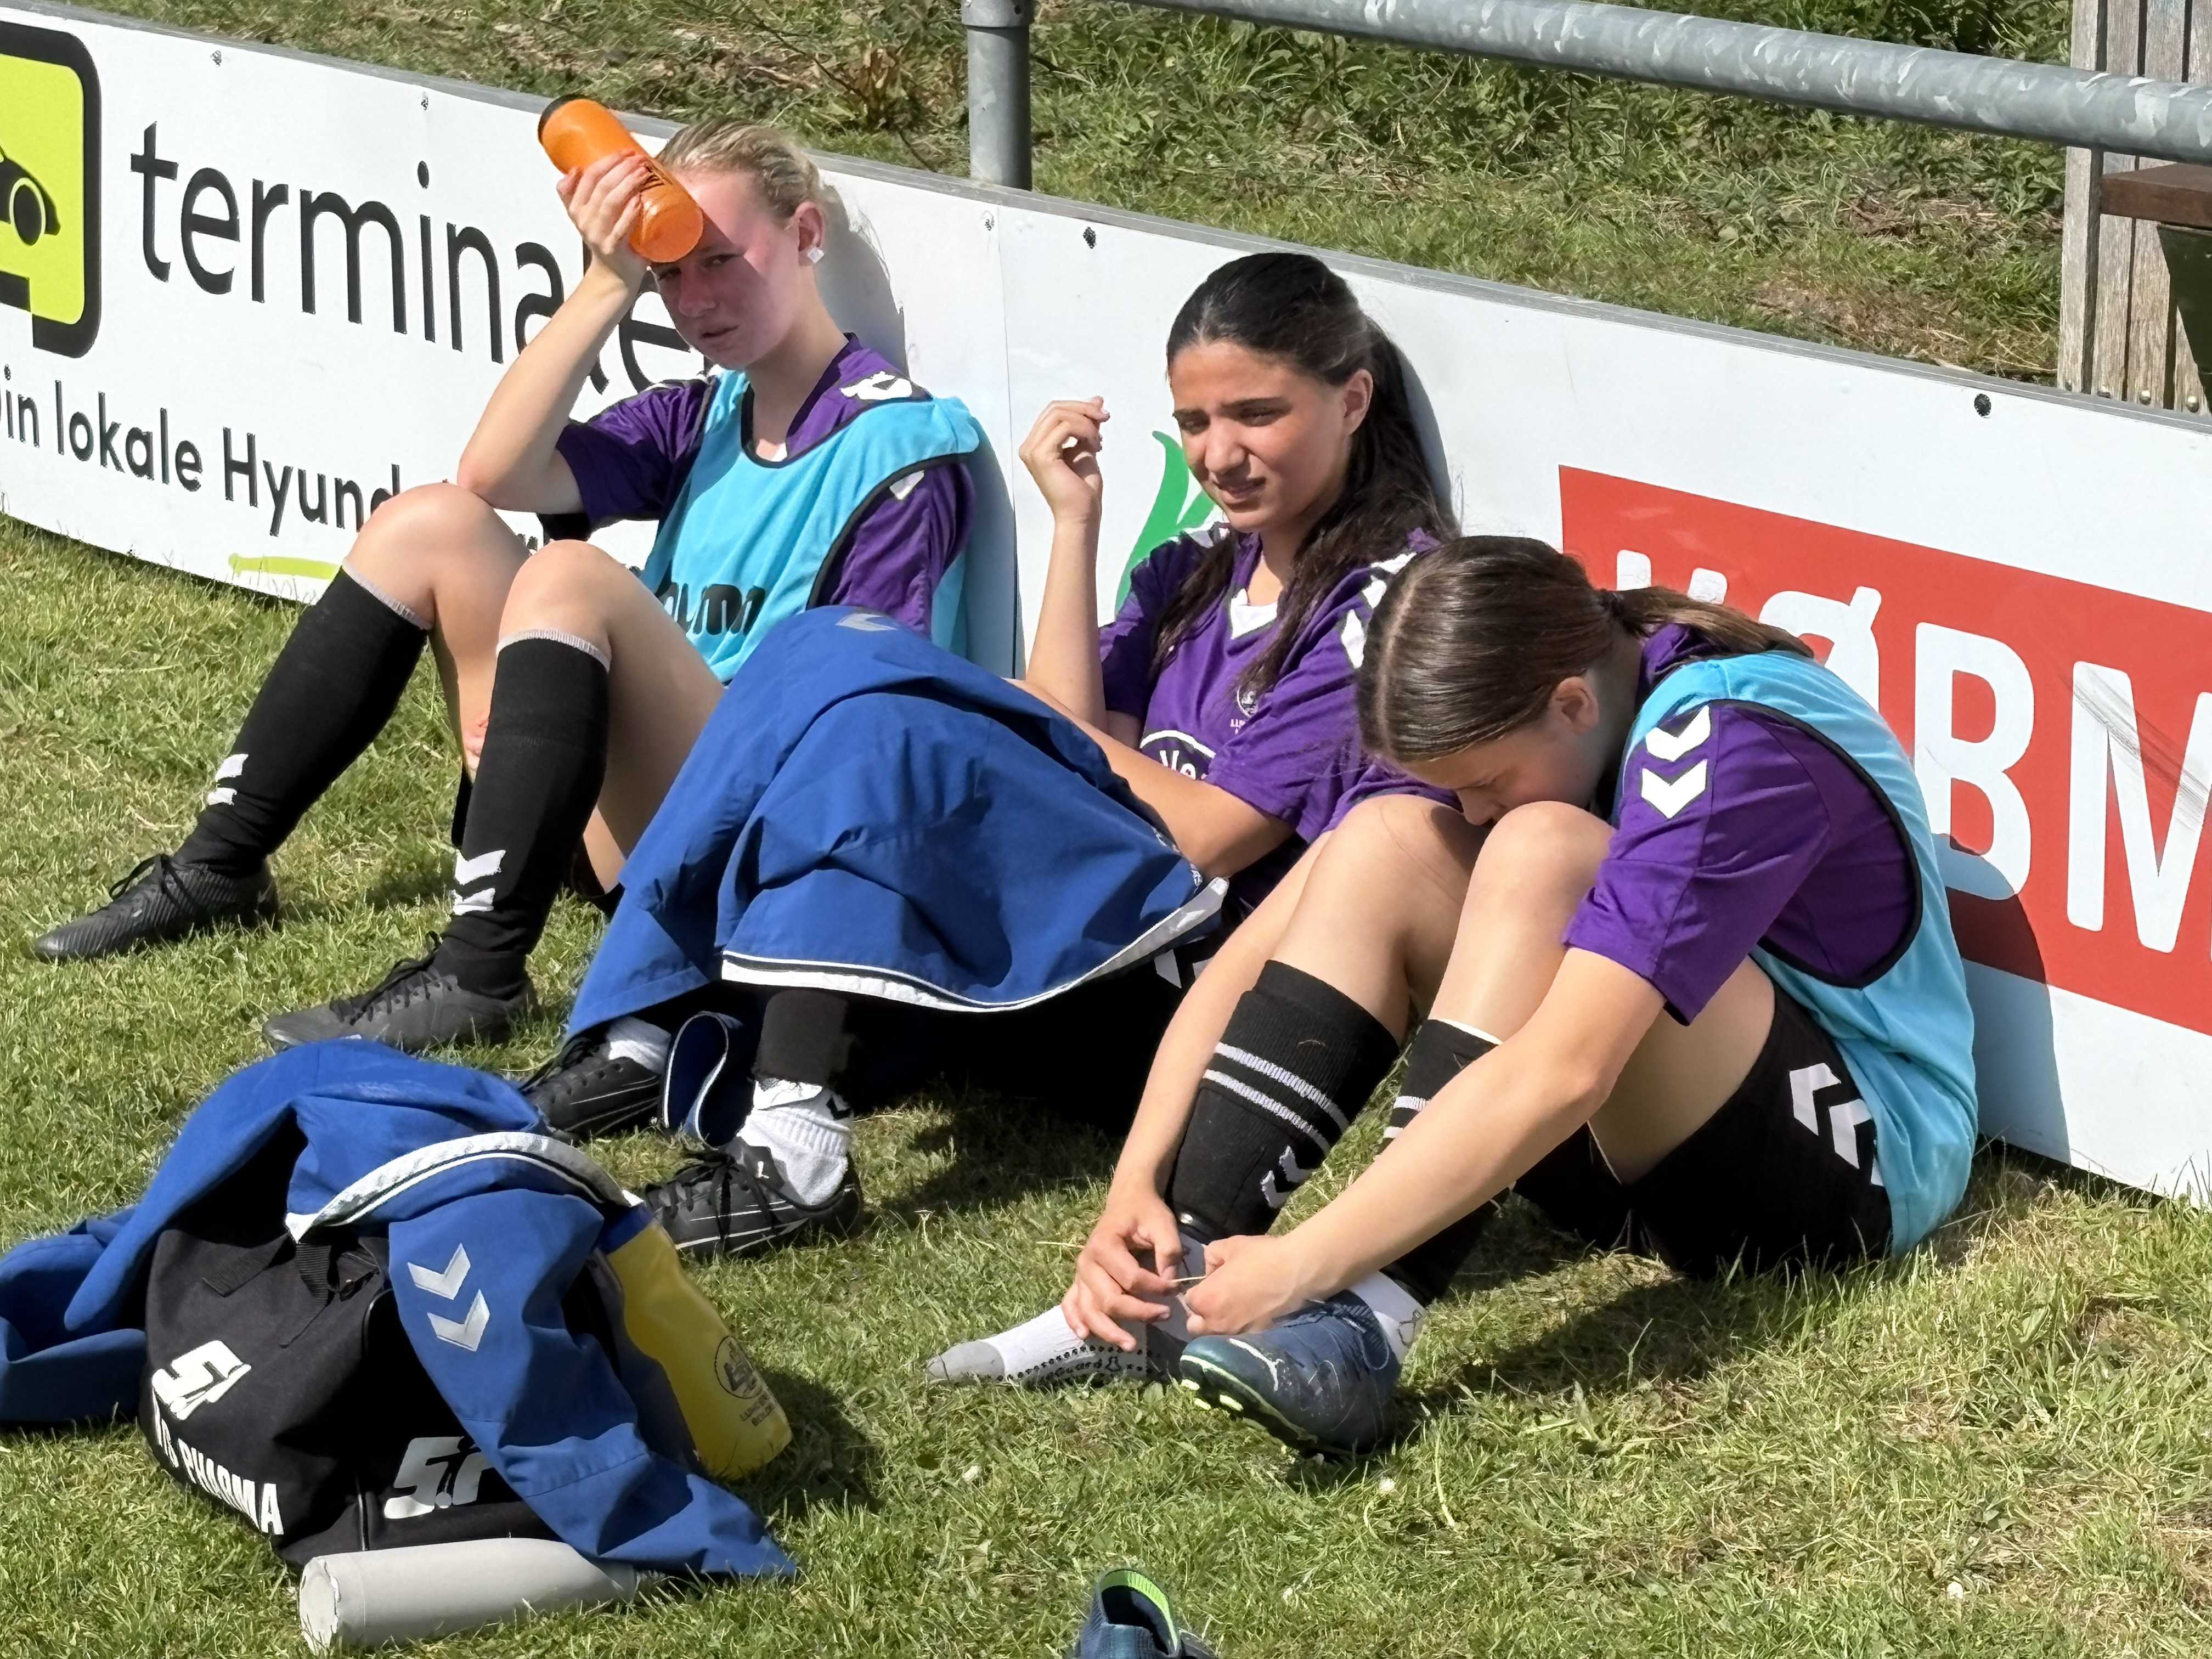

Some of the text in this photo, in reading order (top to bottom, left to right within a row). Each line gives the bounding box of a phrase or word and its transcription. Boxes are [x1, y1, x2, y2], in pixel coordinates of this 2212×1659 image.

[131, 120, 712, 395] terminae
[0, 364, 40, 448] in
[55, 379, 203, 492] lokale
